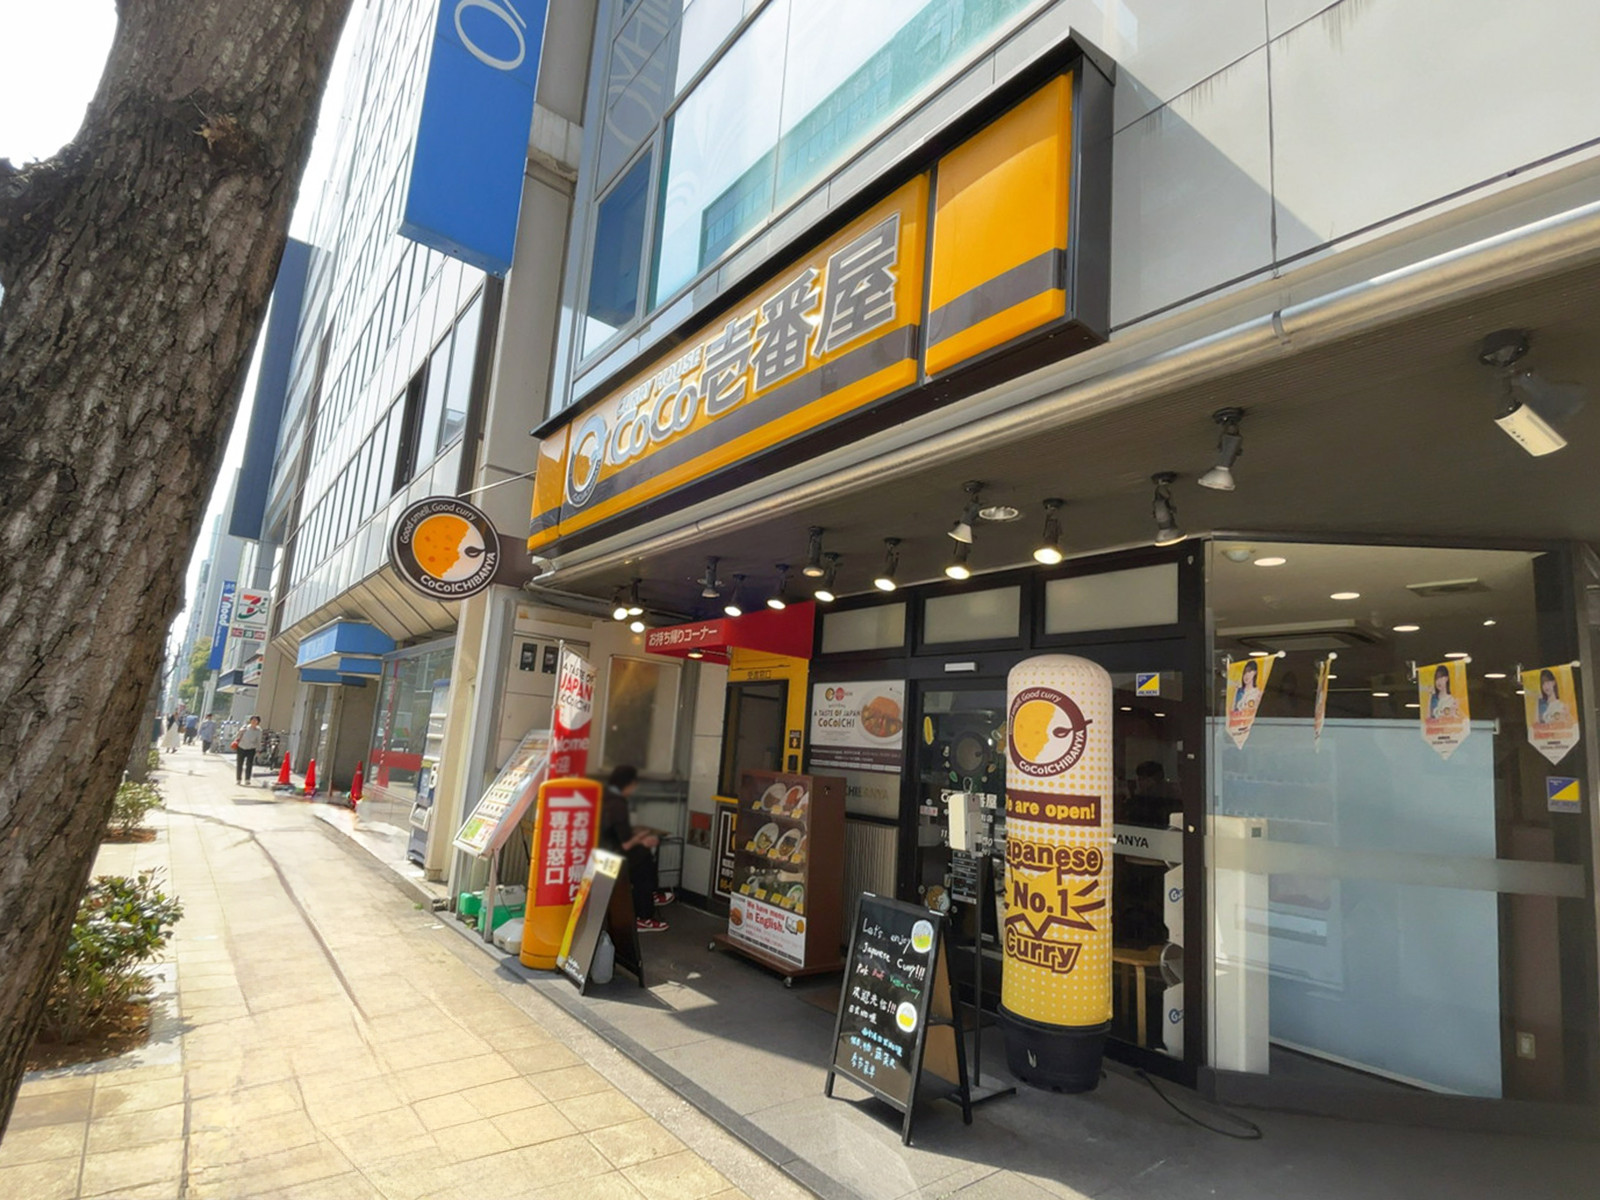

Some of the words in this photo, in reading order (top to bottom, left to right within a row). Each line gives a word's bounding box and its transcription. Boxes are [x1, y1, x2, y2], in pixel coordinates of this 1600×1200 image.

[432, 502, 456, 513] Good
[455, 506, 477, 521] curry
[648, 625, 718, 646] お持ち帰りコーナー
[1021, 690, 1040, 700] Good
[1041, 692, 1062, 703] curry
[1019, 730, 1084, 775] CoCoICHIBANYA
[1015, 800, 1040, 816] are
[1045, 802, 1096, 820] open!
[545, 811, 570, 885] 専用窓口
[890, 935, 912, 955] enjoy
[1006, 924, 1082, 974] Curry
